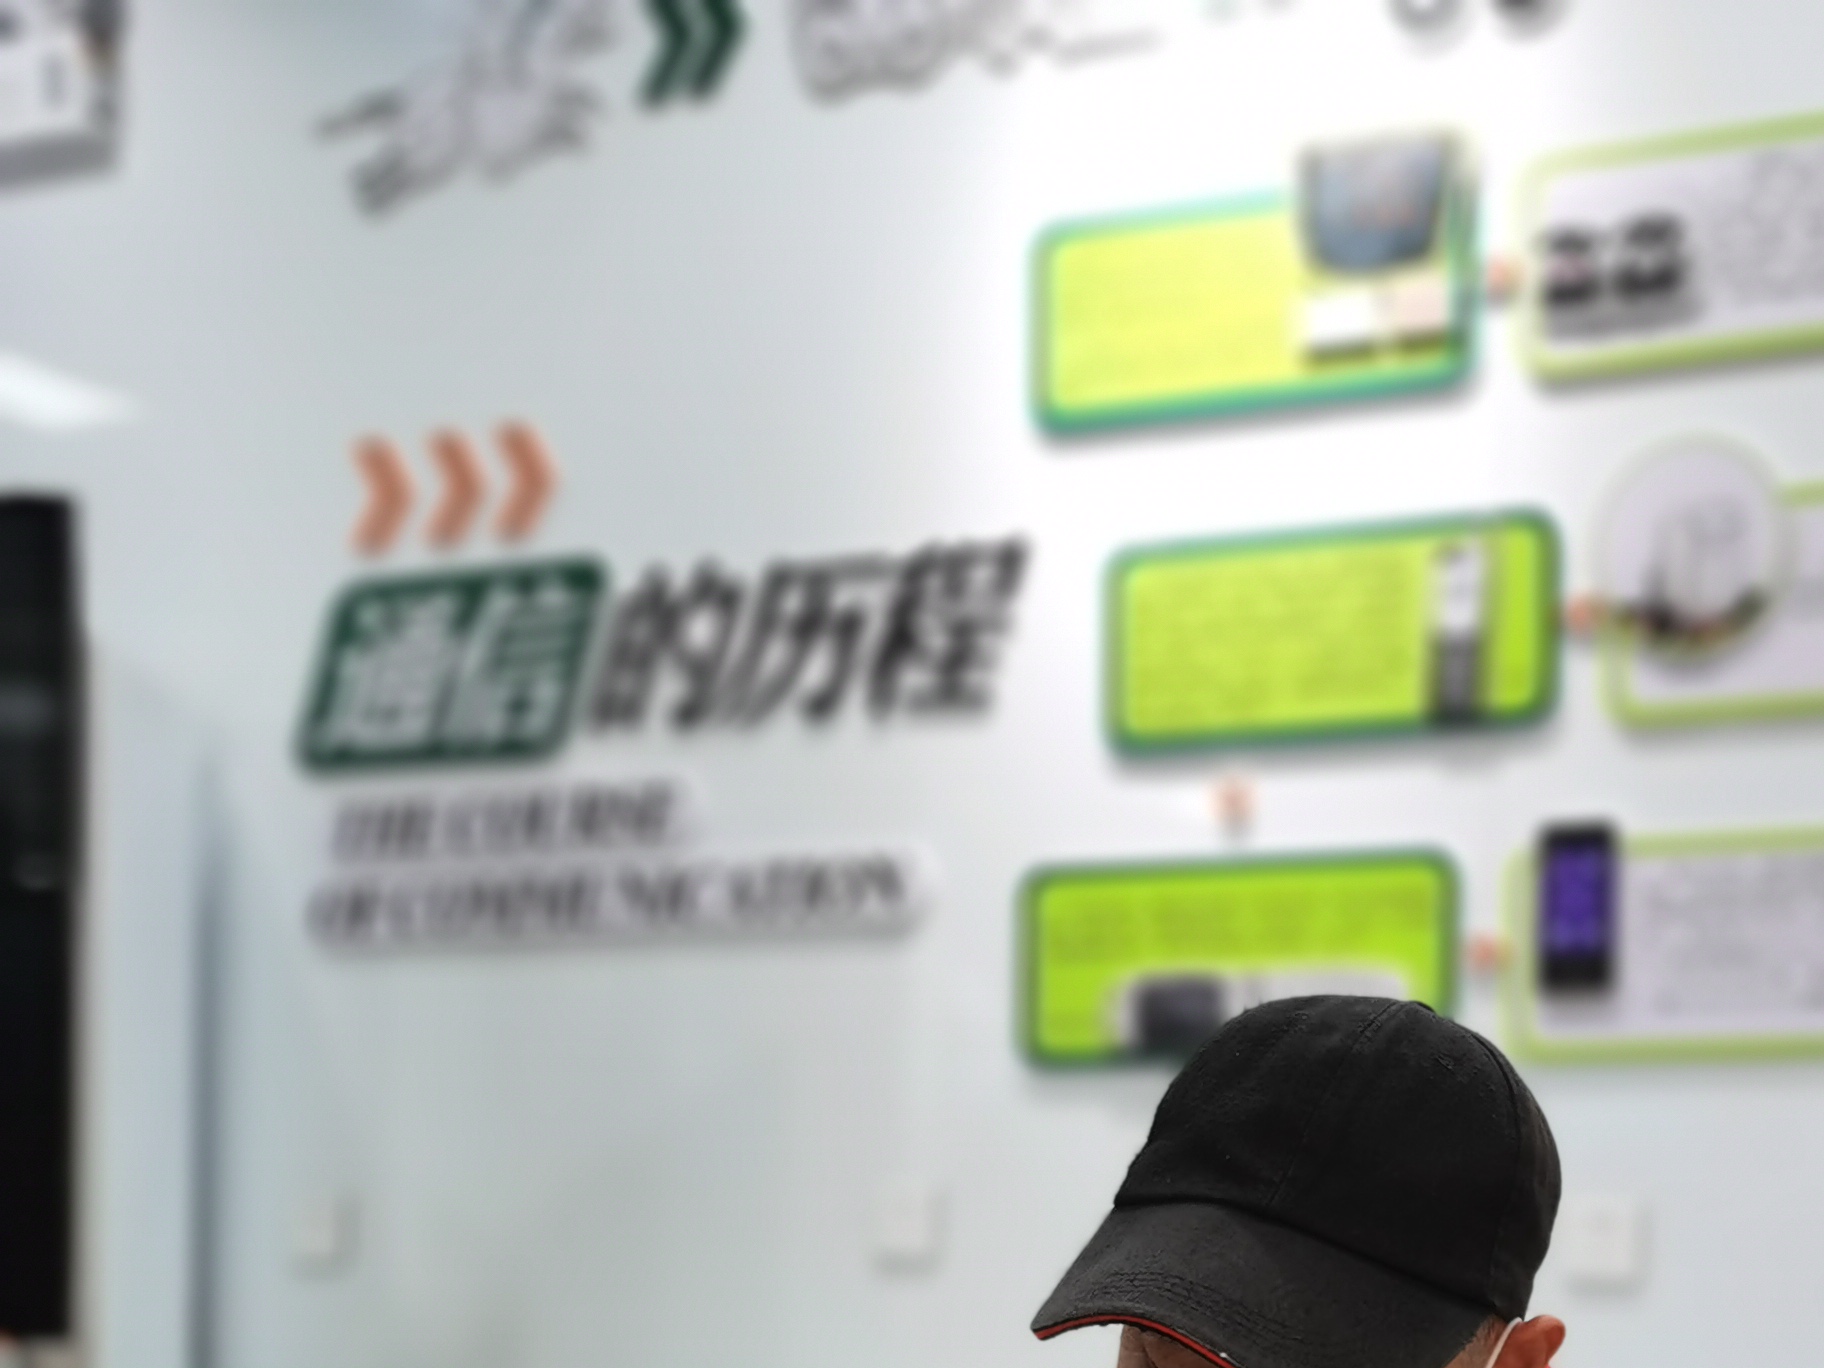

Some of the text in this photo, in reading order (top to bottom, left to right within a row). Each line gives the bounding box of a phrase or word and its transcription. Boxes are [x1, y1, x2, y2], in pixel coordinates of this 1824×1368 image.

[325, 538, 1028, 742] 通信的历程
